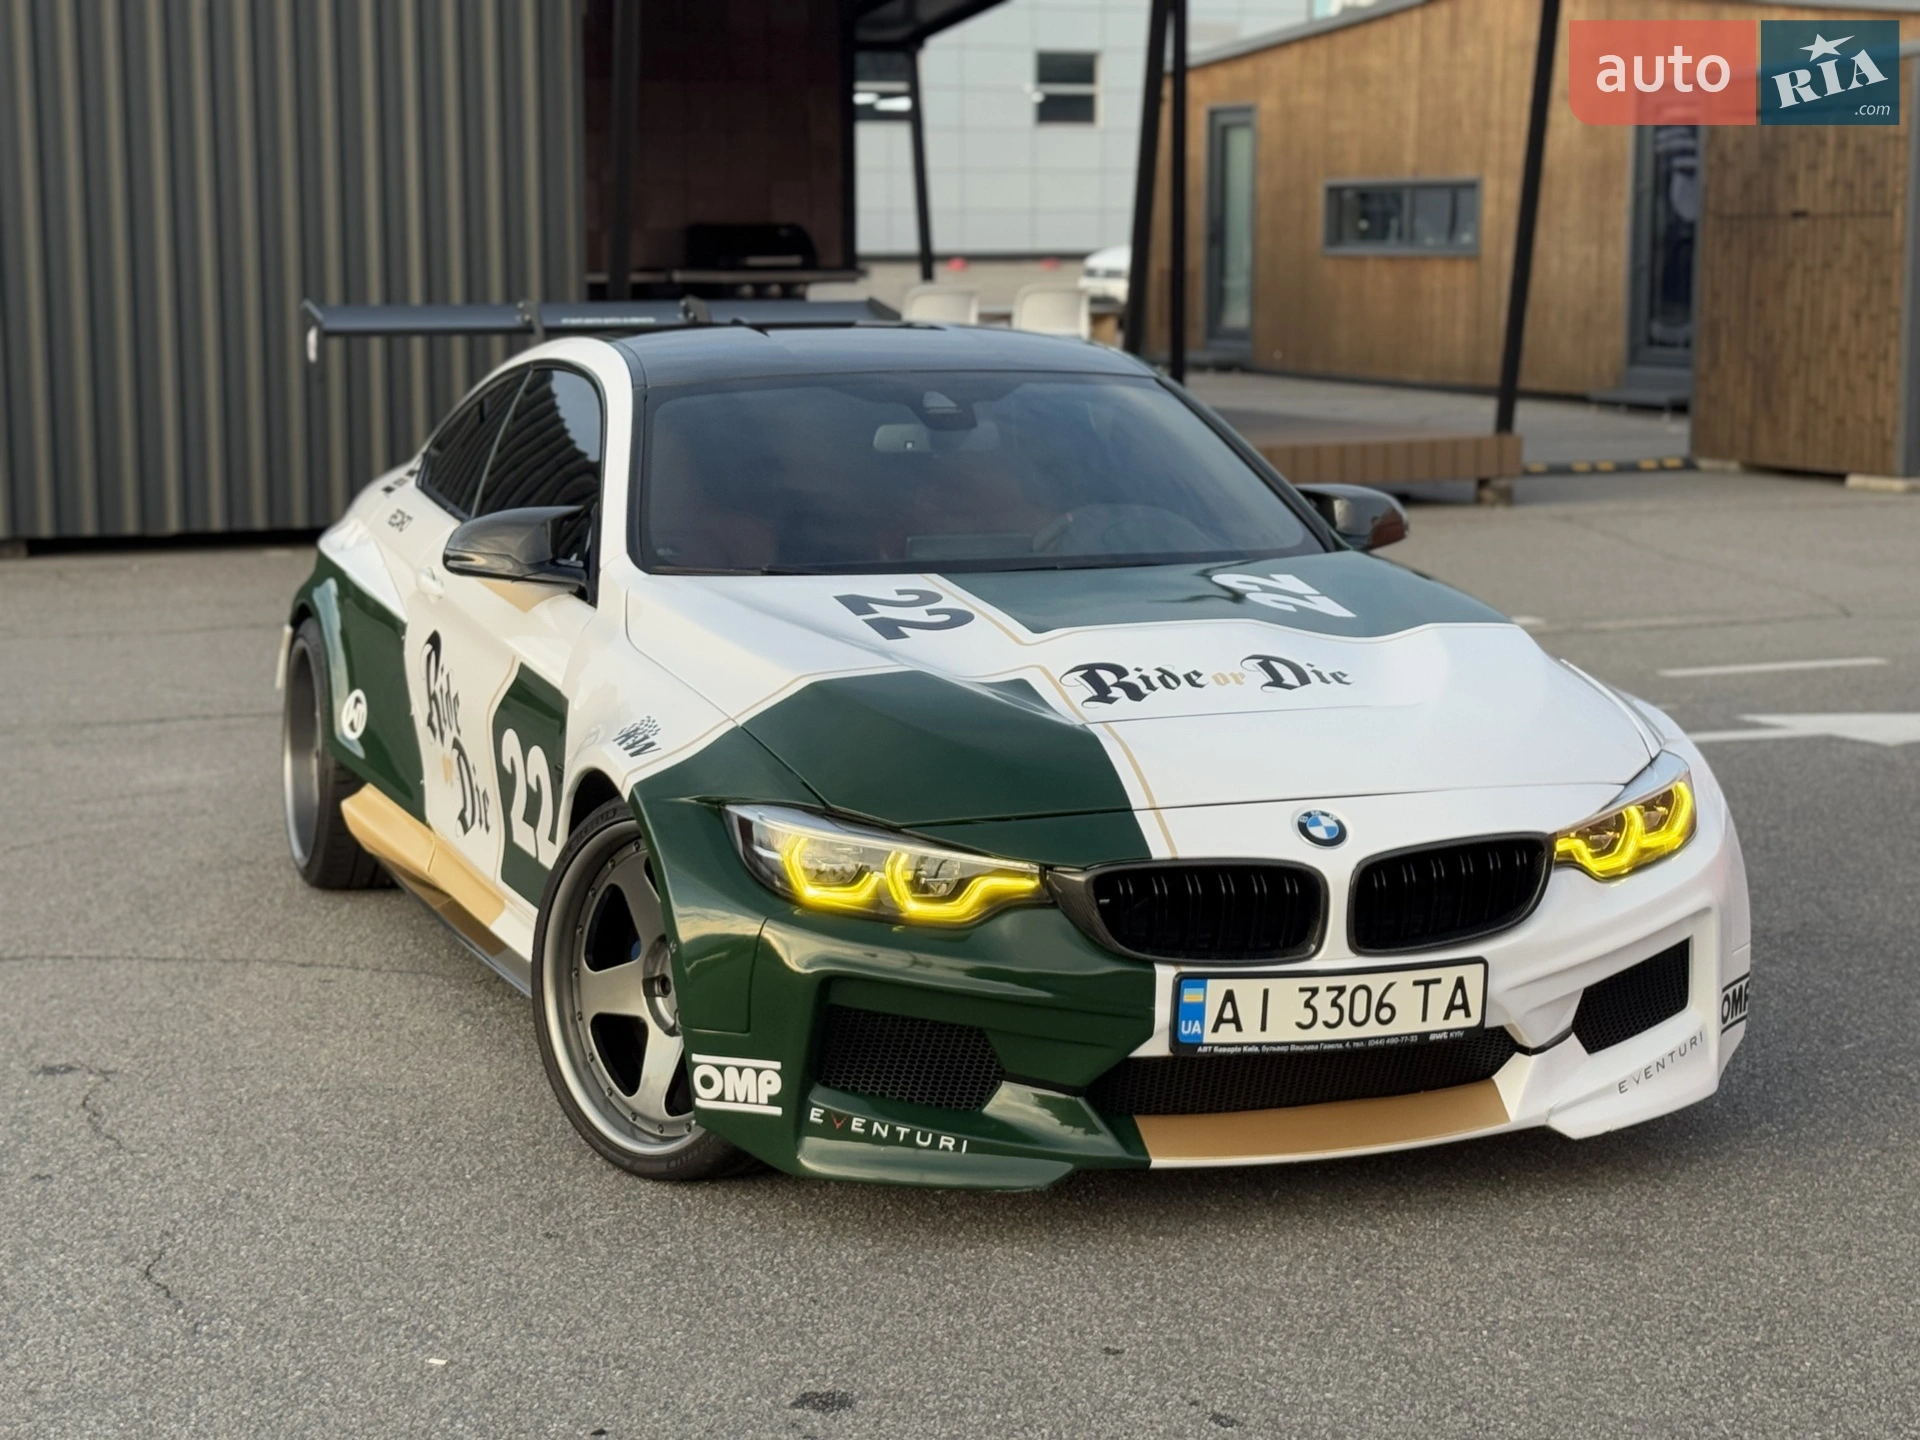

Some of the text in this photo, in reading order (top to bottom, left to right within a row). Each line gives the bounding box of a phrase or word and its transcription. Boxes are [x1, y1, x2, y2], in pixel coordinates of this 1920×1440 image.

[833, 588, 975, 640] 22
[1211, 573, 1358, 618] 22
[1059, 654, 1353, 708] Ride or Die
[502, 728, 557, 871] 22
[1181, 1019, 1202, 1034] UA
[1211, 975, 1473, 1034] AI 3306 TA
[693, 1064, 782, 1105] OMP
[1618, 1031, 1704, 1095] EVENTURI
[809, 1107, 968, 1154] EVENTURI
